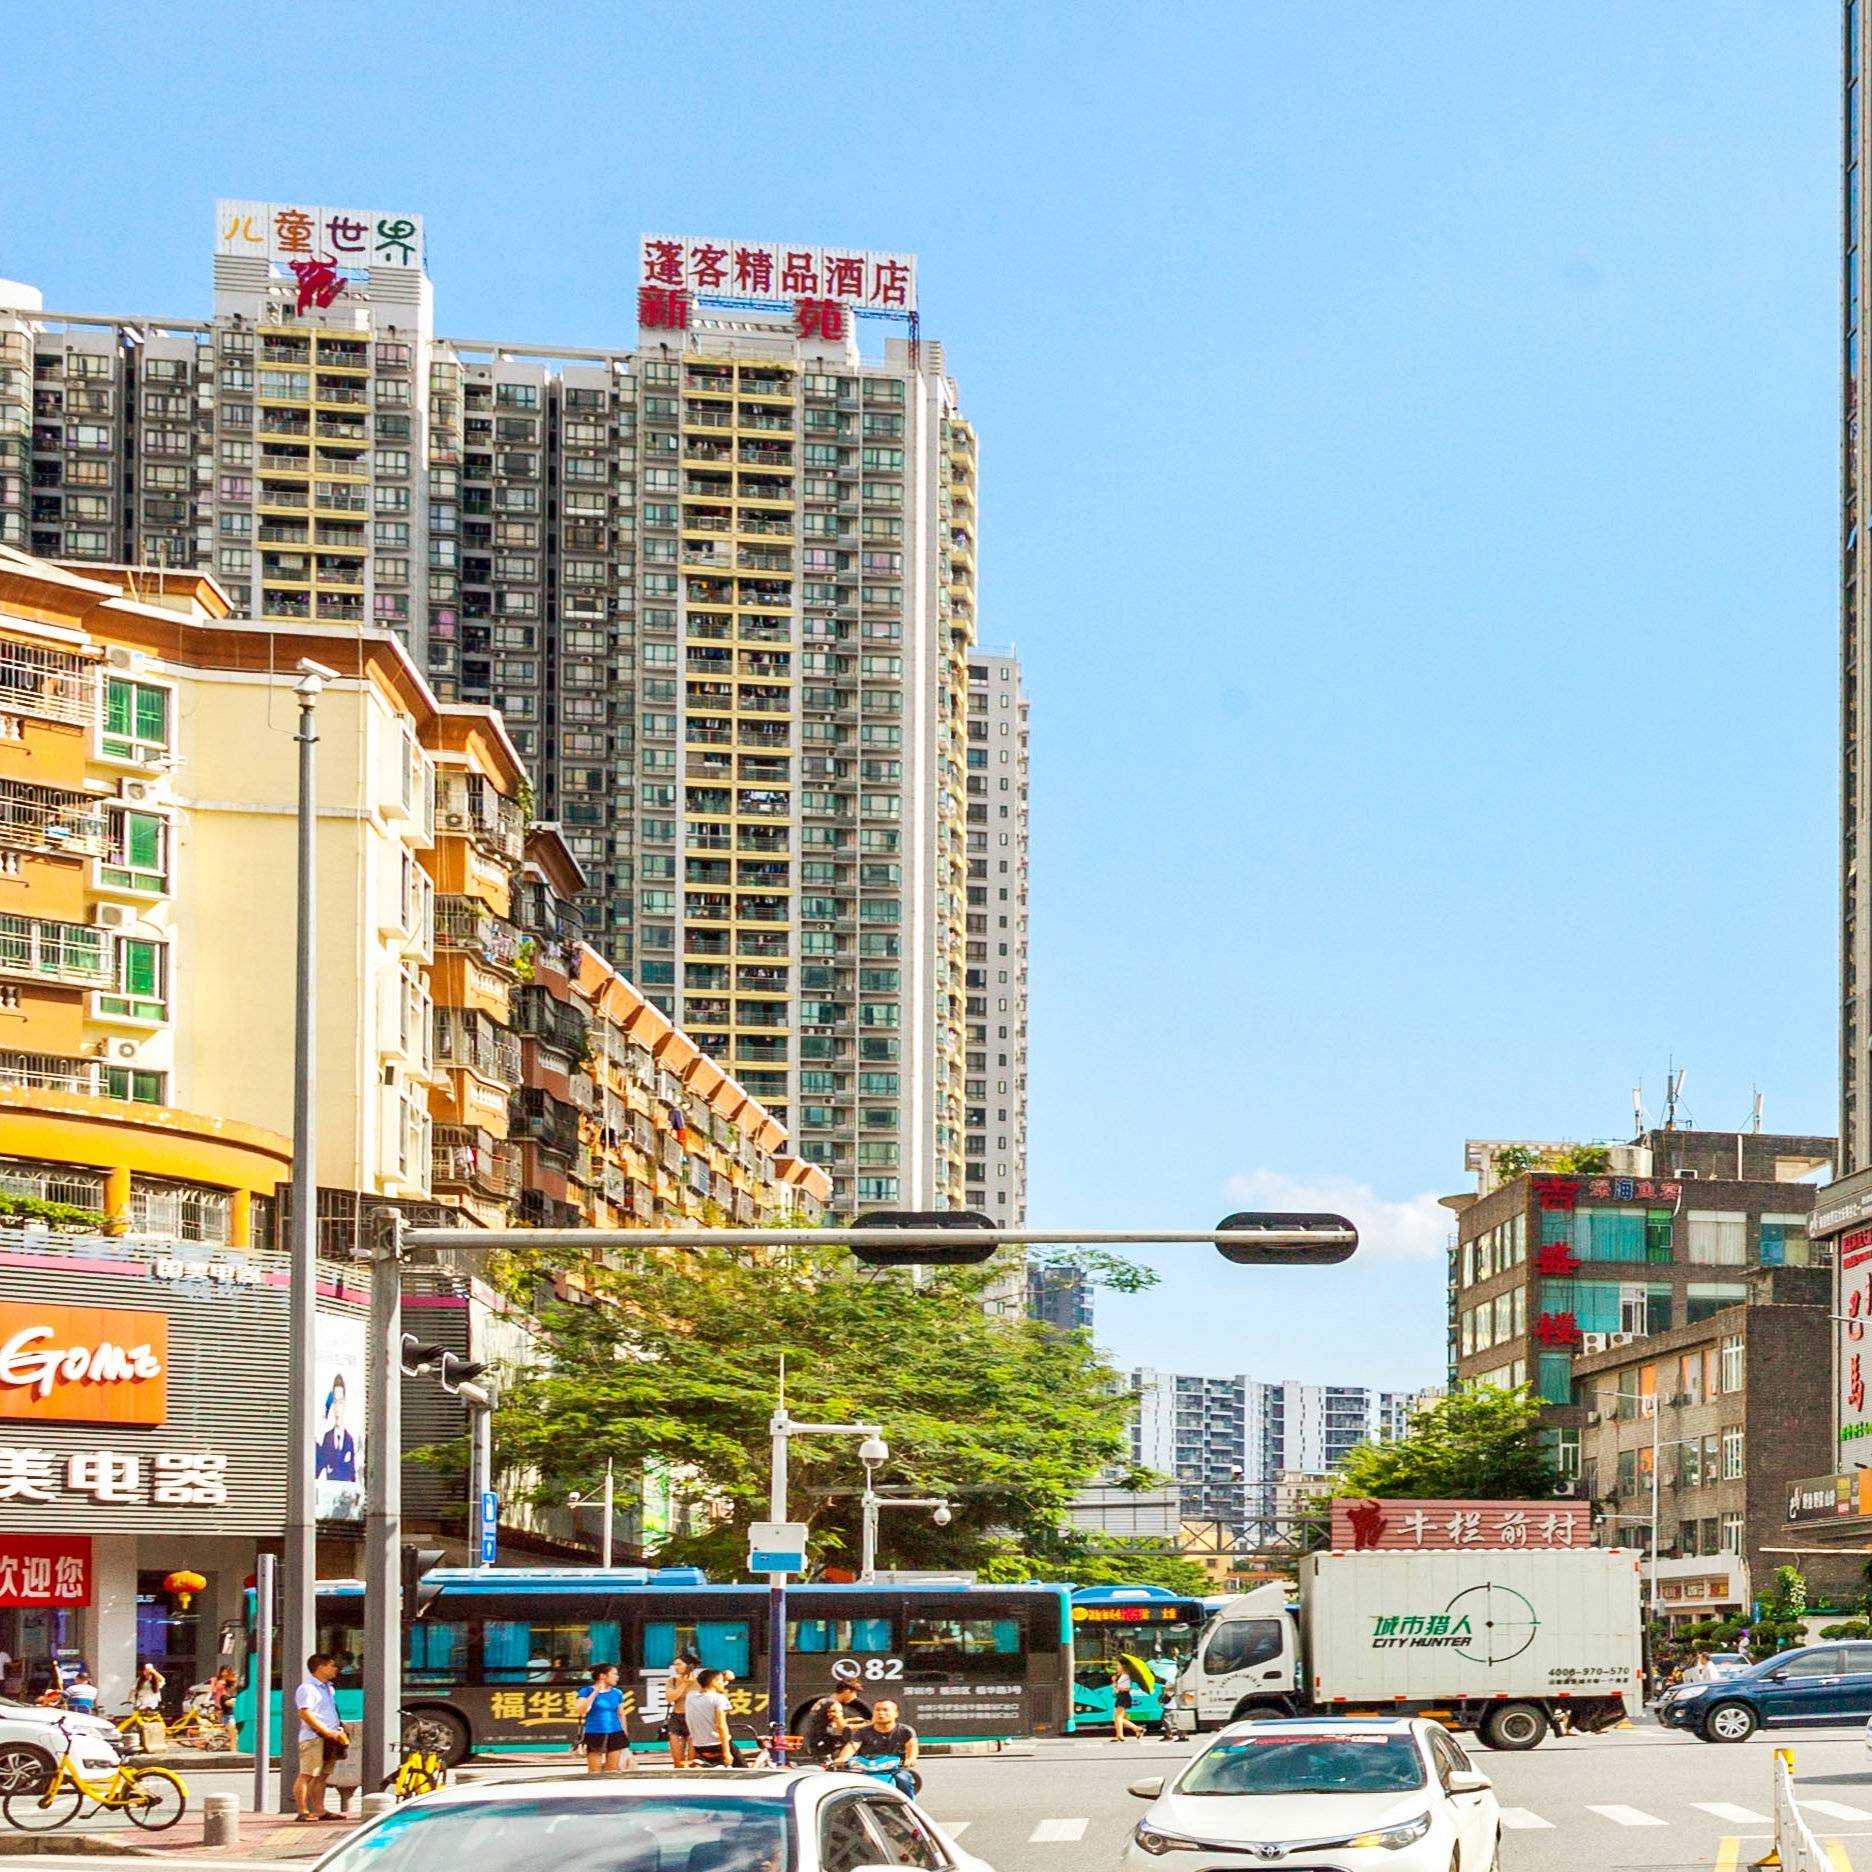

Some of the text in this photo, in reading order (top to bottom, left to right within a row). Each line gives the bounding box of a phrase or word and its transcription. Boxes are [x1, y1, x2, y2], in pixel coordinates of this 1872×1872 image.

[223, 208, 418, 266] 儿童世界
[643, 240, 910, 306] 蓬客精品酒店
[1396, 1508, 1578, 1546] 牛栏前村
[1372, 1637, 1472, 1648] CITY HUNTER
[1373, 1614, 1473, 1636] 城市猎人
